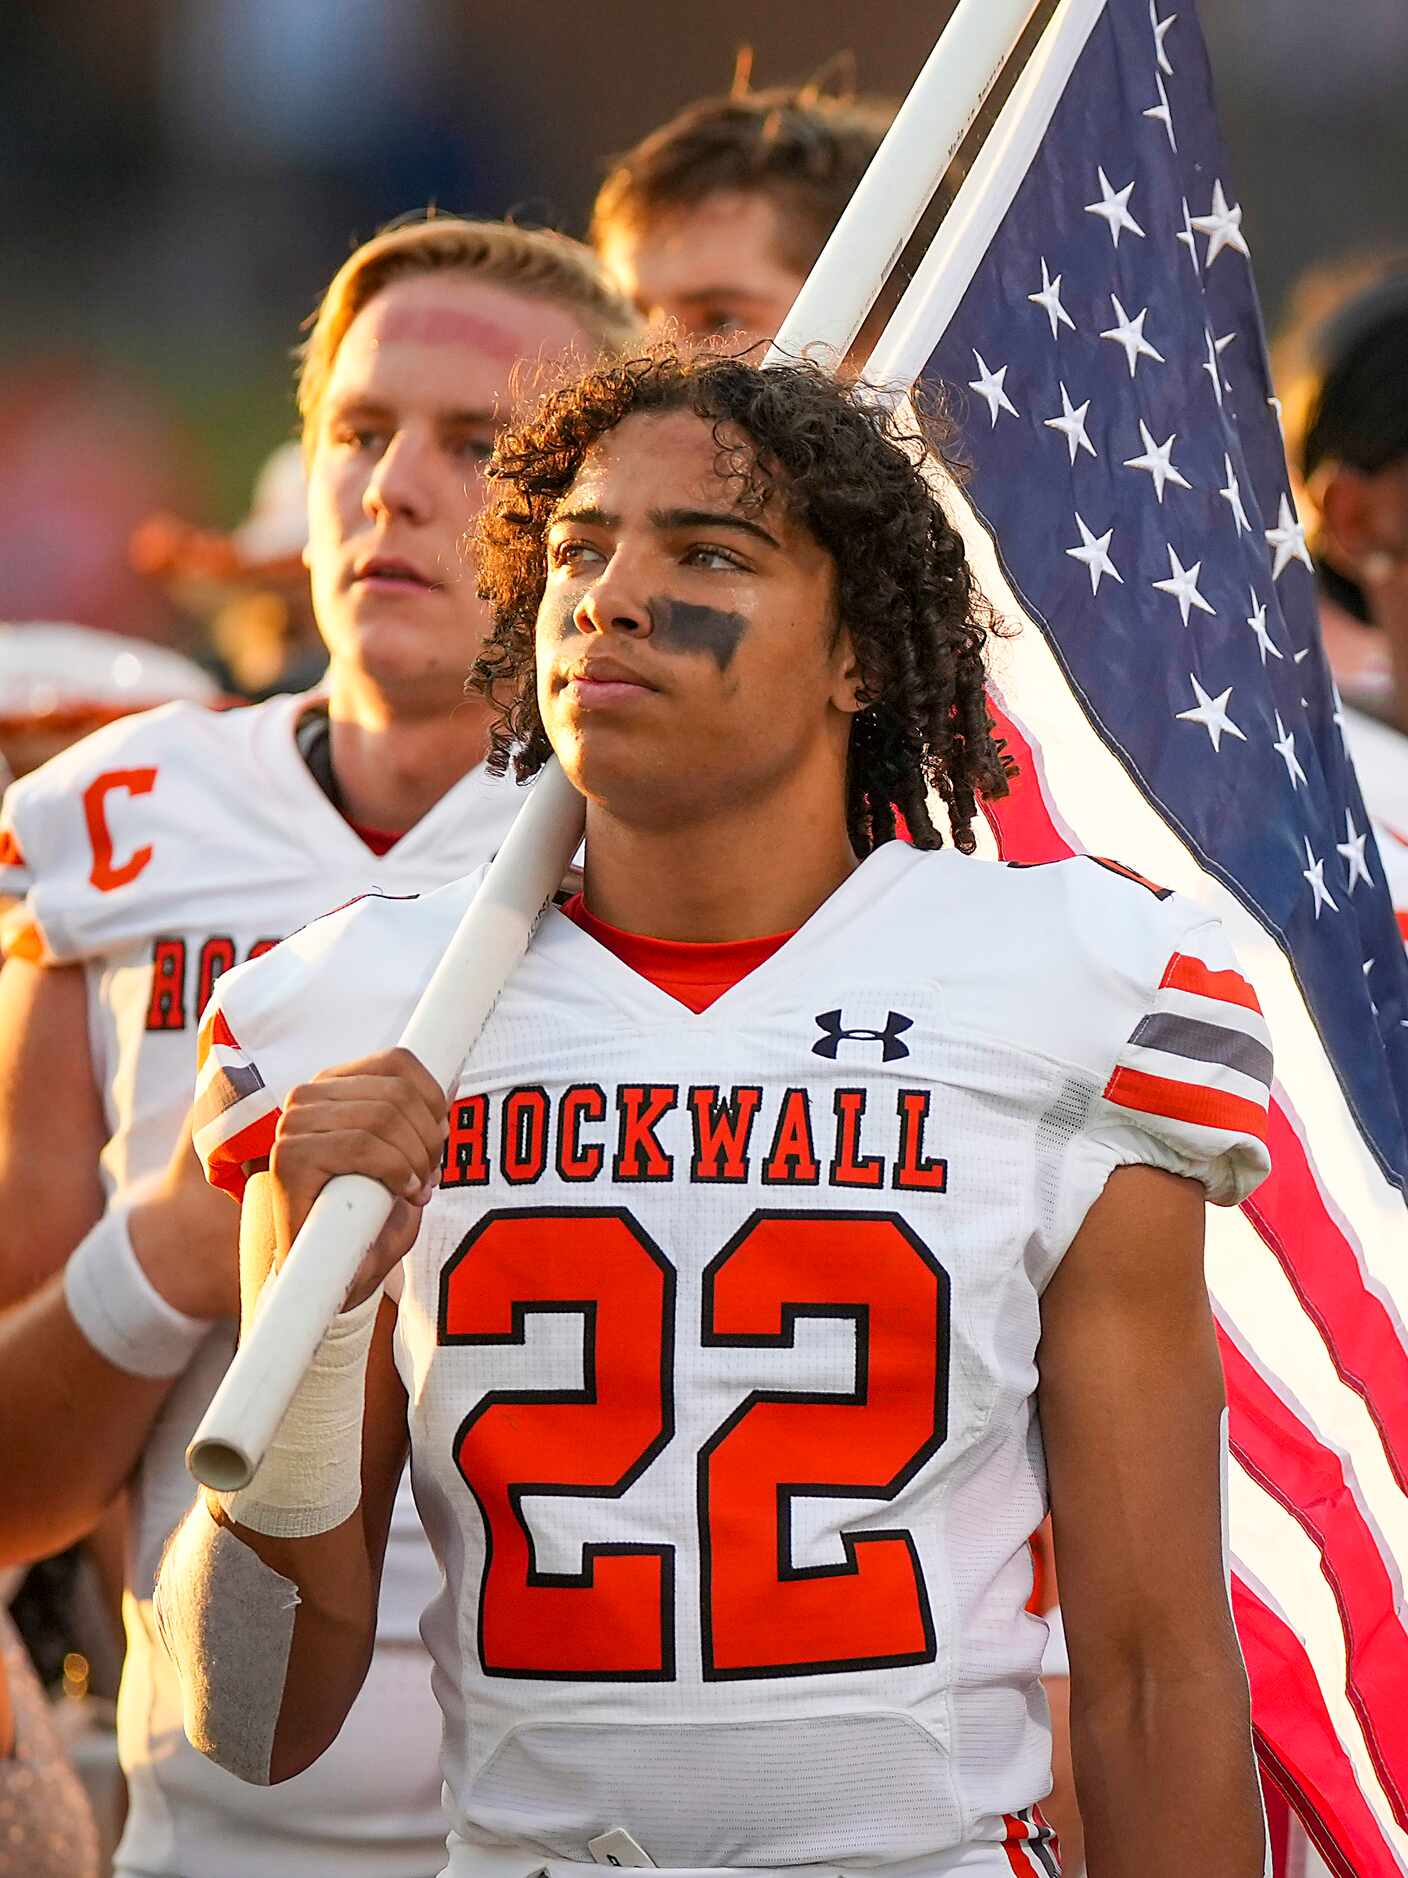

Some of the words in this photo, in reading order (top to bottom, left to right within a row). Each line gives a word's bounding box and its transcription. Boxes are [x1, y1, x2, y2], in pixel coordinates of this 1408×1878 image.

[83, 767, 158, 892] C
[145, 934, 284, 1030] RO
[440, 1084, 948, 1193] ROCKWALL
[437, 1206, 951, 1684] 22
